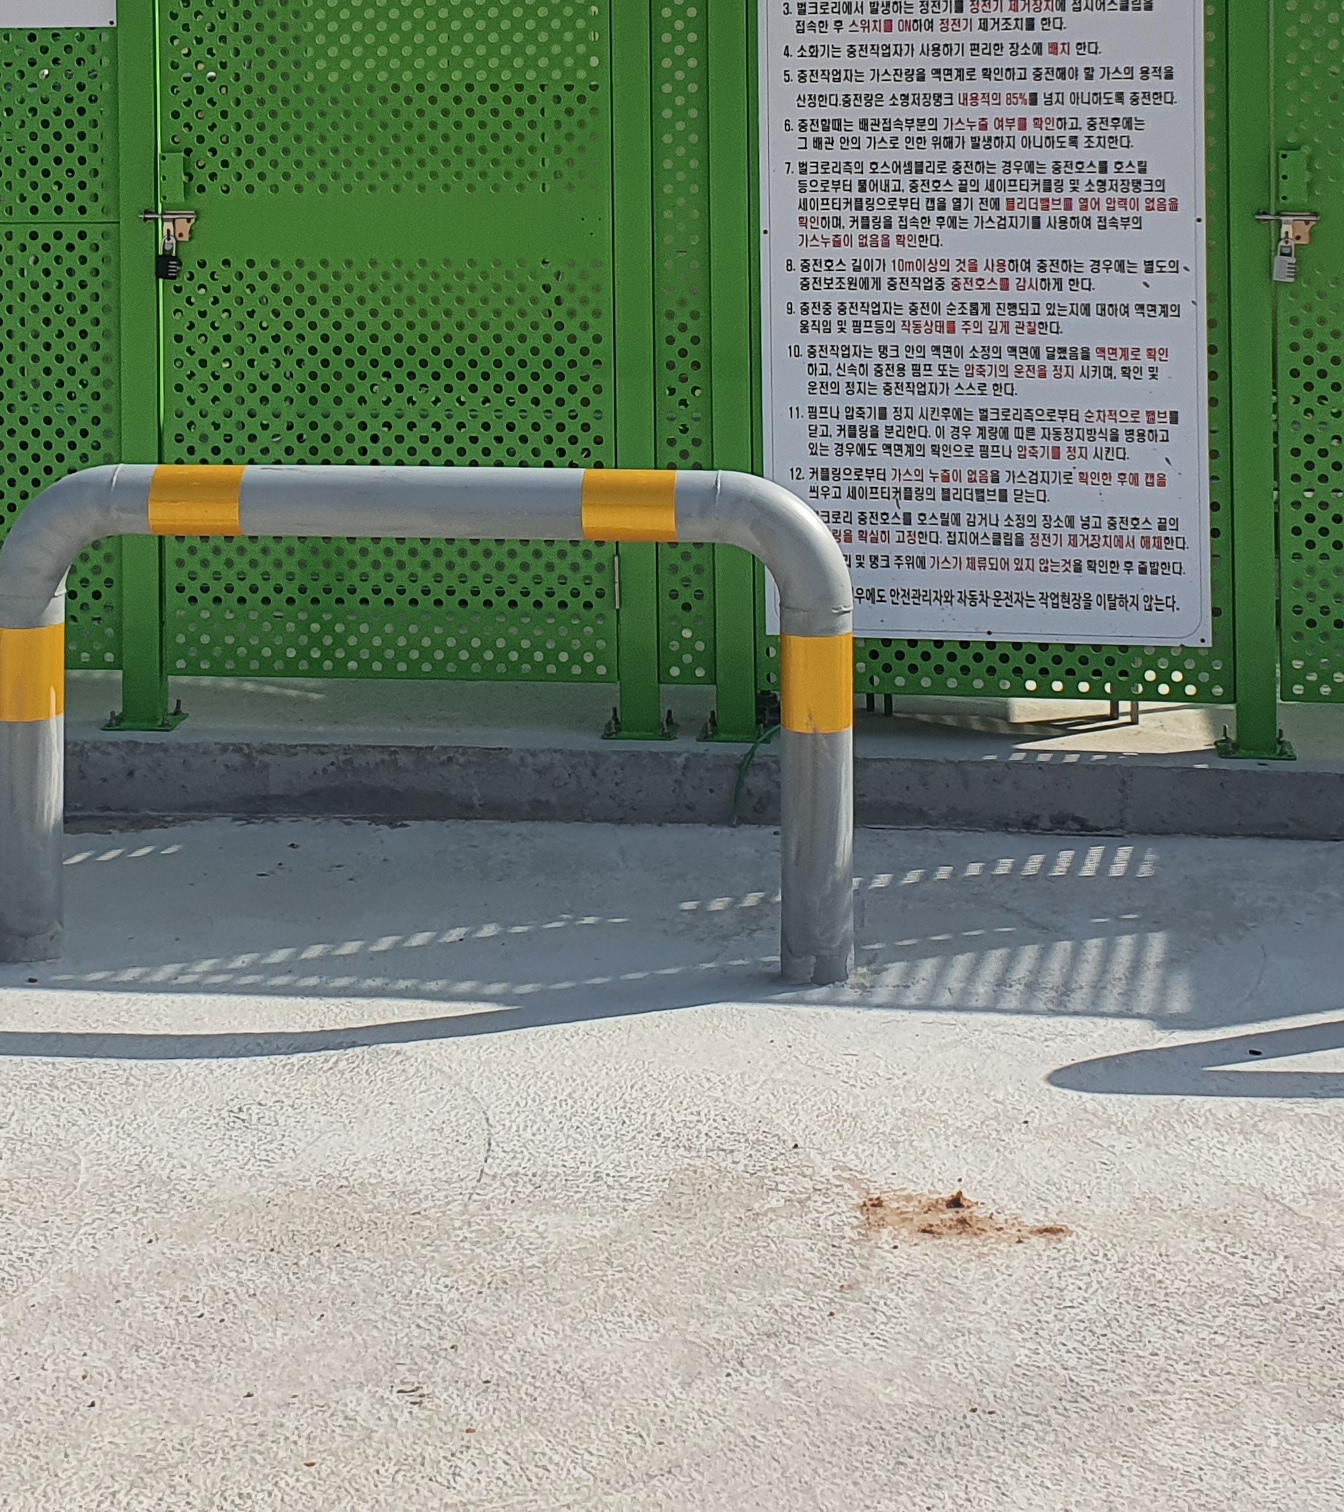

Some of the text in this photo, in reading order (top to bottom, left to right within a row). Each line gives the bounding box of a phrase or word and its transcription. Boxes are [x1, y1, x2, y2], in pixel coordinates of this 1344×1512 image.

[795, 16, 1066, 34] 접속한 후 스위치를 ON하여 정전기 제거조치를 한다.
[783, 41, 1102, 58] 4. 소화기는 충전작업자가 사용하기 편리한 장소에 배치 한다.
[784, 116, 1145, 133] 6. 충전할때는 배관접속부분의 가스누출 여부를 확인하고, 충전후에는
[797, 134, 1134, 150] 그 배관 안의 가스로 인한 위해가 발생하지 아니하도록 조치한다.
[798, 215, 1142, 230] 확인하며, 커플링을 접속한 후에는 가스검지기를 사용하여 접속부의
[798, 233, 853, 248] 가스누출이
[895, 233, 943, 248] 확인한다.
[799, 276, 1095, 292] 충전보조원에게 충전작업중 충전호스를 감시하게 한다.
[799, 319, 1063, 335] 움직임 및 펌프등의 작동상태를 주의 깊게 관찰한다.
[807, 362, 1158, 380] 하고, 신속히 충전용 펌프 또는 압축기의 운전을 정지 시키며, 확인 및
[807, 380, 1018, 397] 운전의 정지는 충전작업자가 스스로 한다.
[808, 442, 1129, 461] 있는 경우에도 액면계의 확인으로 펌프나 압축기를 정지 시킨다.
[846, 485, 936, 502] 세이프티커플링의
[1013, 488, 1050, 503] 닫는다.
[851, 585, 1180, 612] 우에도 안전관리자와 자동차 운전자는 작업현장을 이탈하지 않는다.
